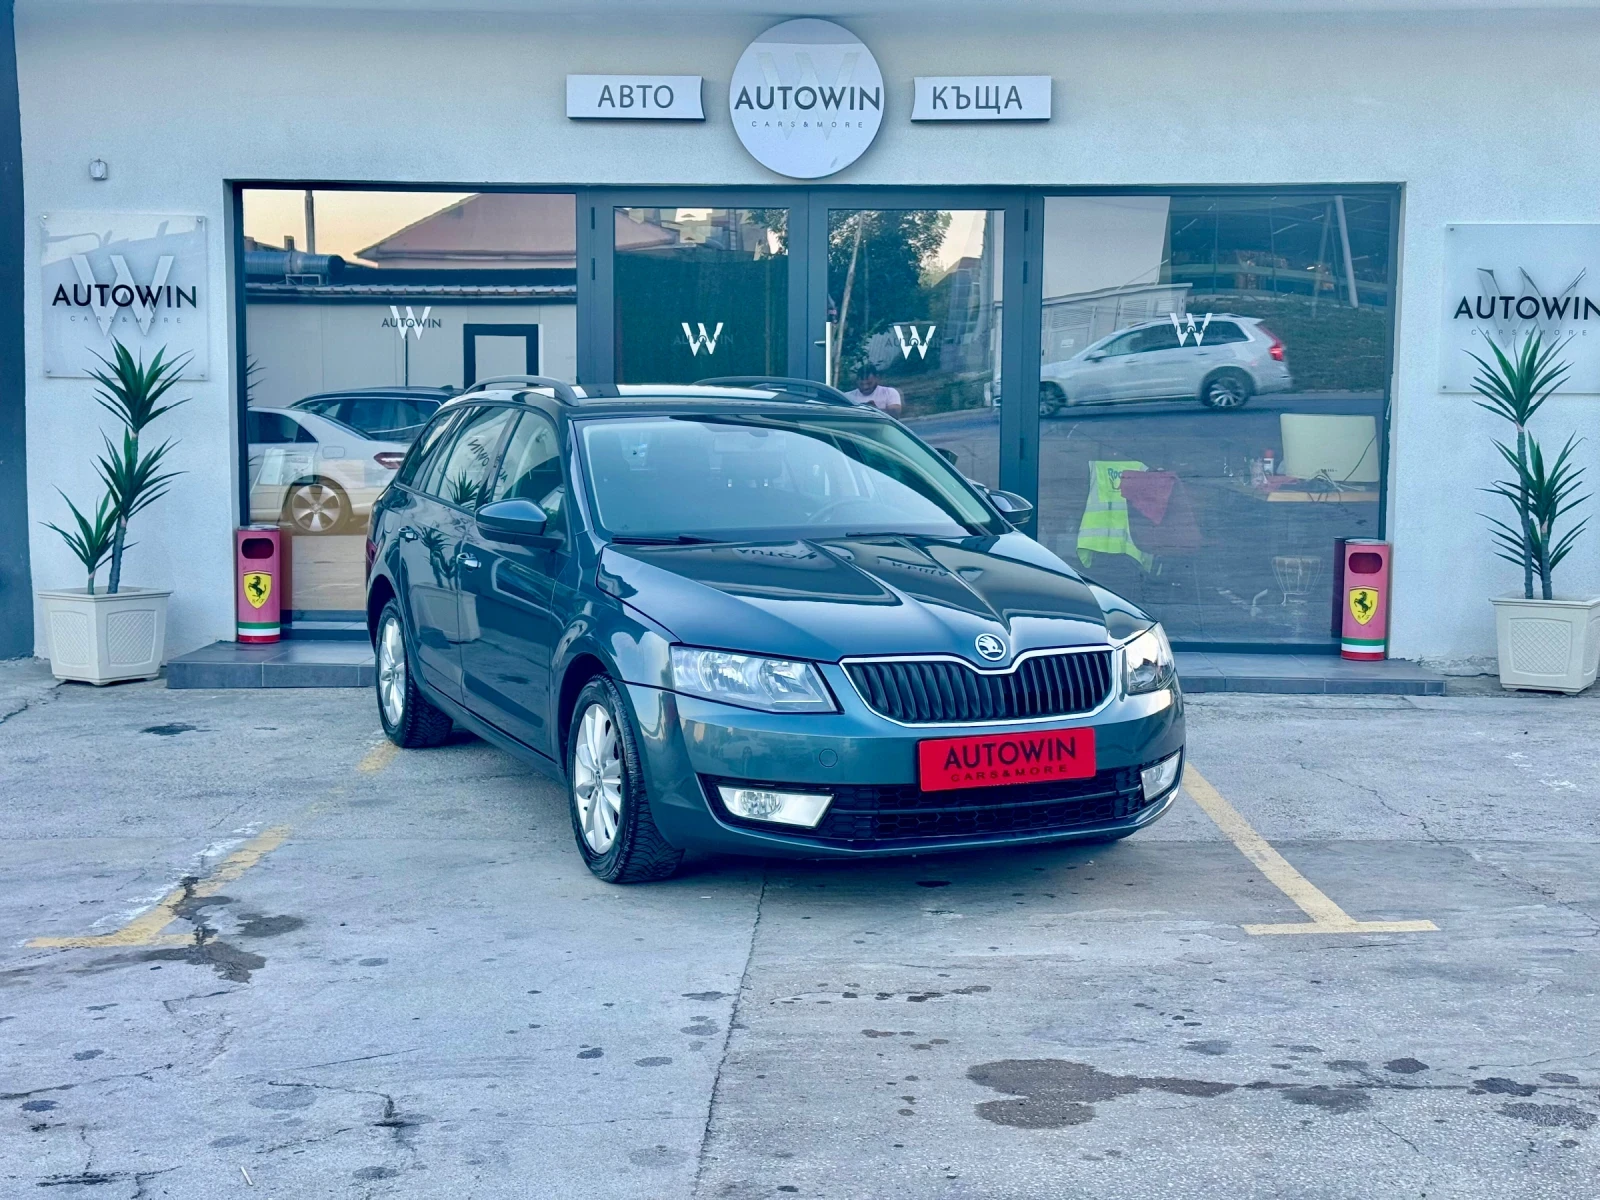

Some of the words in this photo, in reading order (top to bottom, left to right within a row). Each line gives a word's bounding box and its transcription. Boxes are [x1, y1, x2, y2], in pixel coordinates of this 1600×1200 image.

[597, 84, 674, 109] АВТО
[733, 85, 880, 111] AUTOWIN
[932, 85, 1023, 114] КЪЩА
[51, 283, 197, 309] AUTOWIN
[381, 317, 442, 329] AUTOWIN
[943, 735, 1077, 771] AUTOWIN
[950, 763, 1069, 782] CARS&MORE
